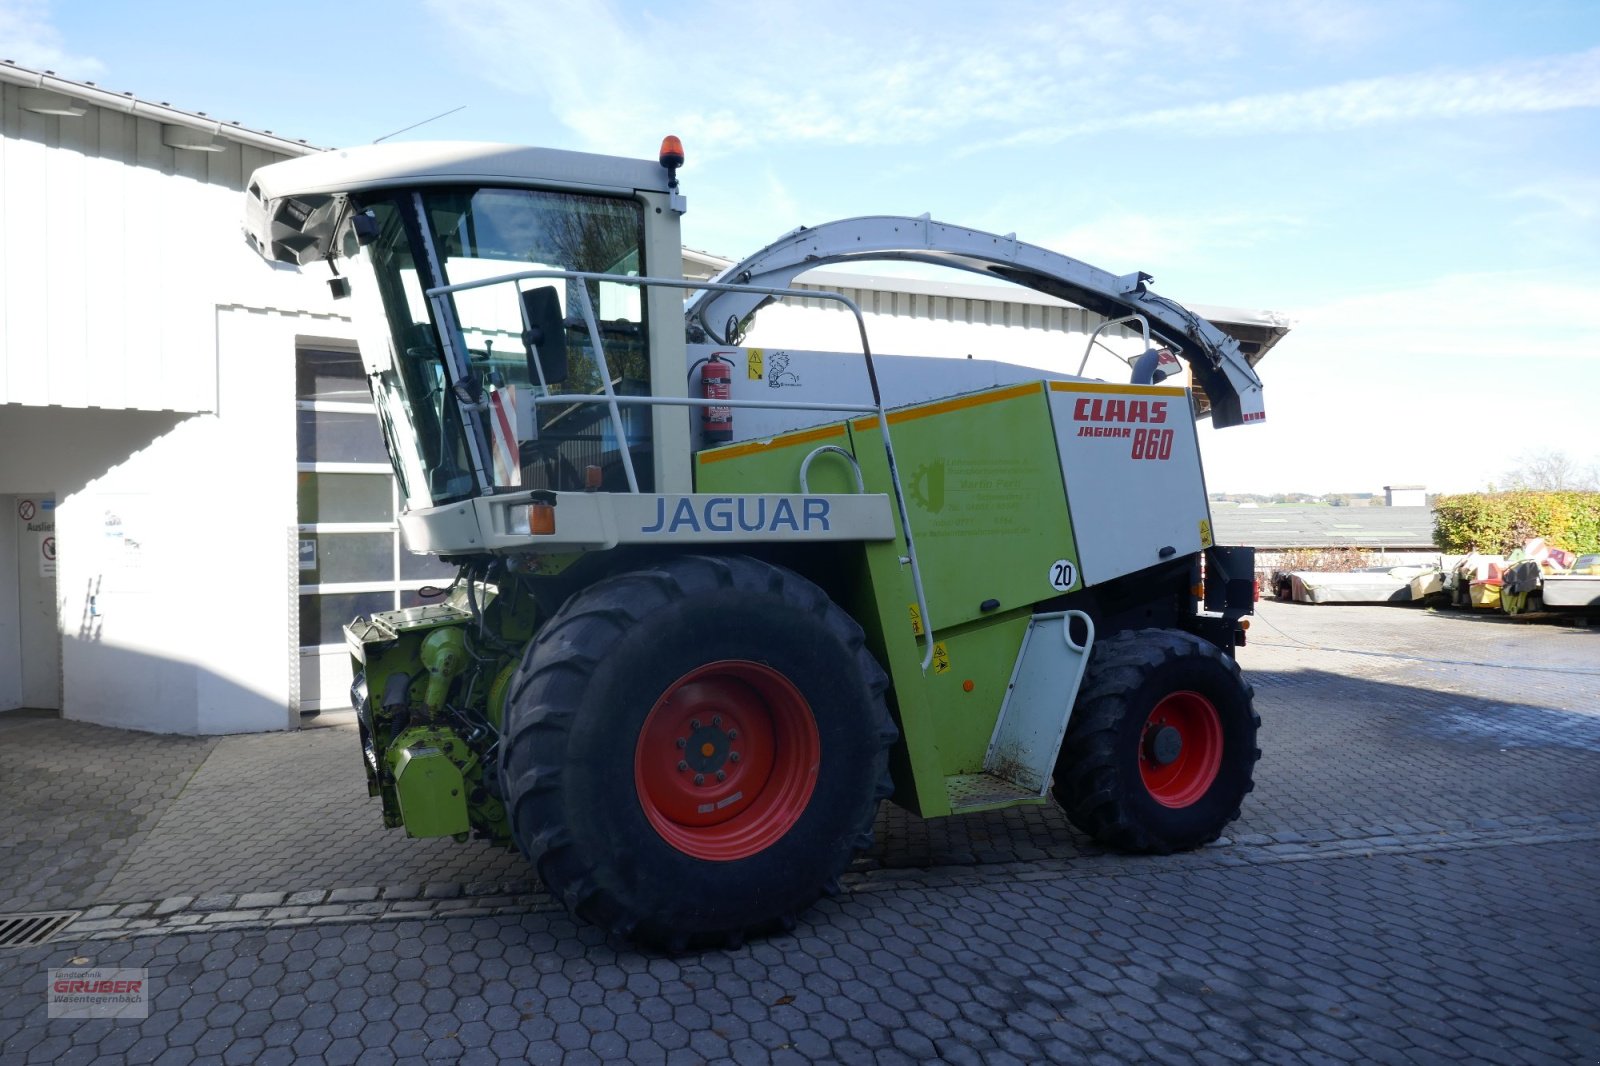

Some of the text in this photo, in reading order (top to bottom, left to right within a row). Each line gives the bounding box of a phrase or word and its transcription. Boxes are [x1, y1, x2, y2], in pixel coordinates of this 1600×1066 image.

[1073, 398, 1167, 423] CLAAS
[1077, 426, 1174, 460] JAGUAR 860
[641, 497, 830, 533] JAGUAR
[1054, 564, 1072, 586] 20
